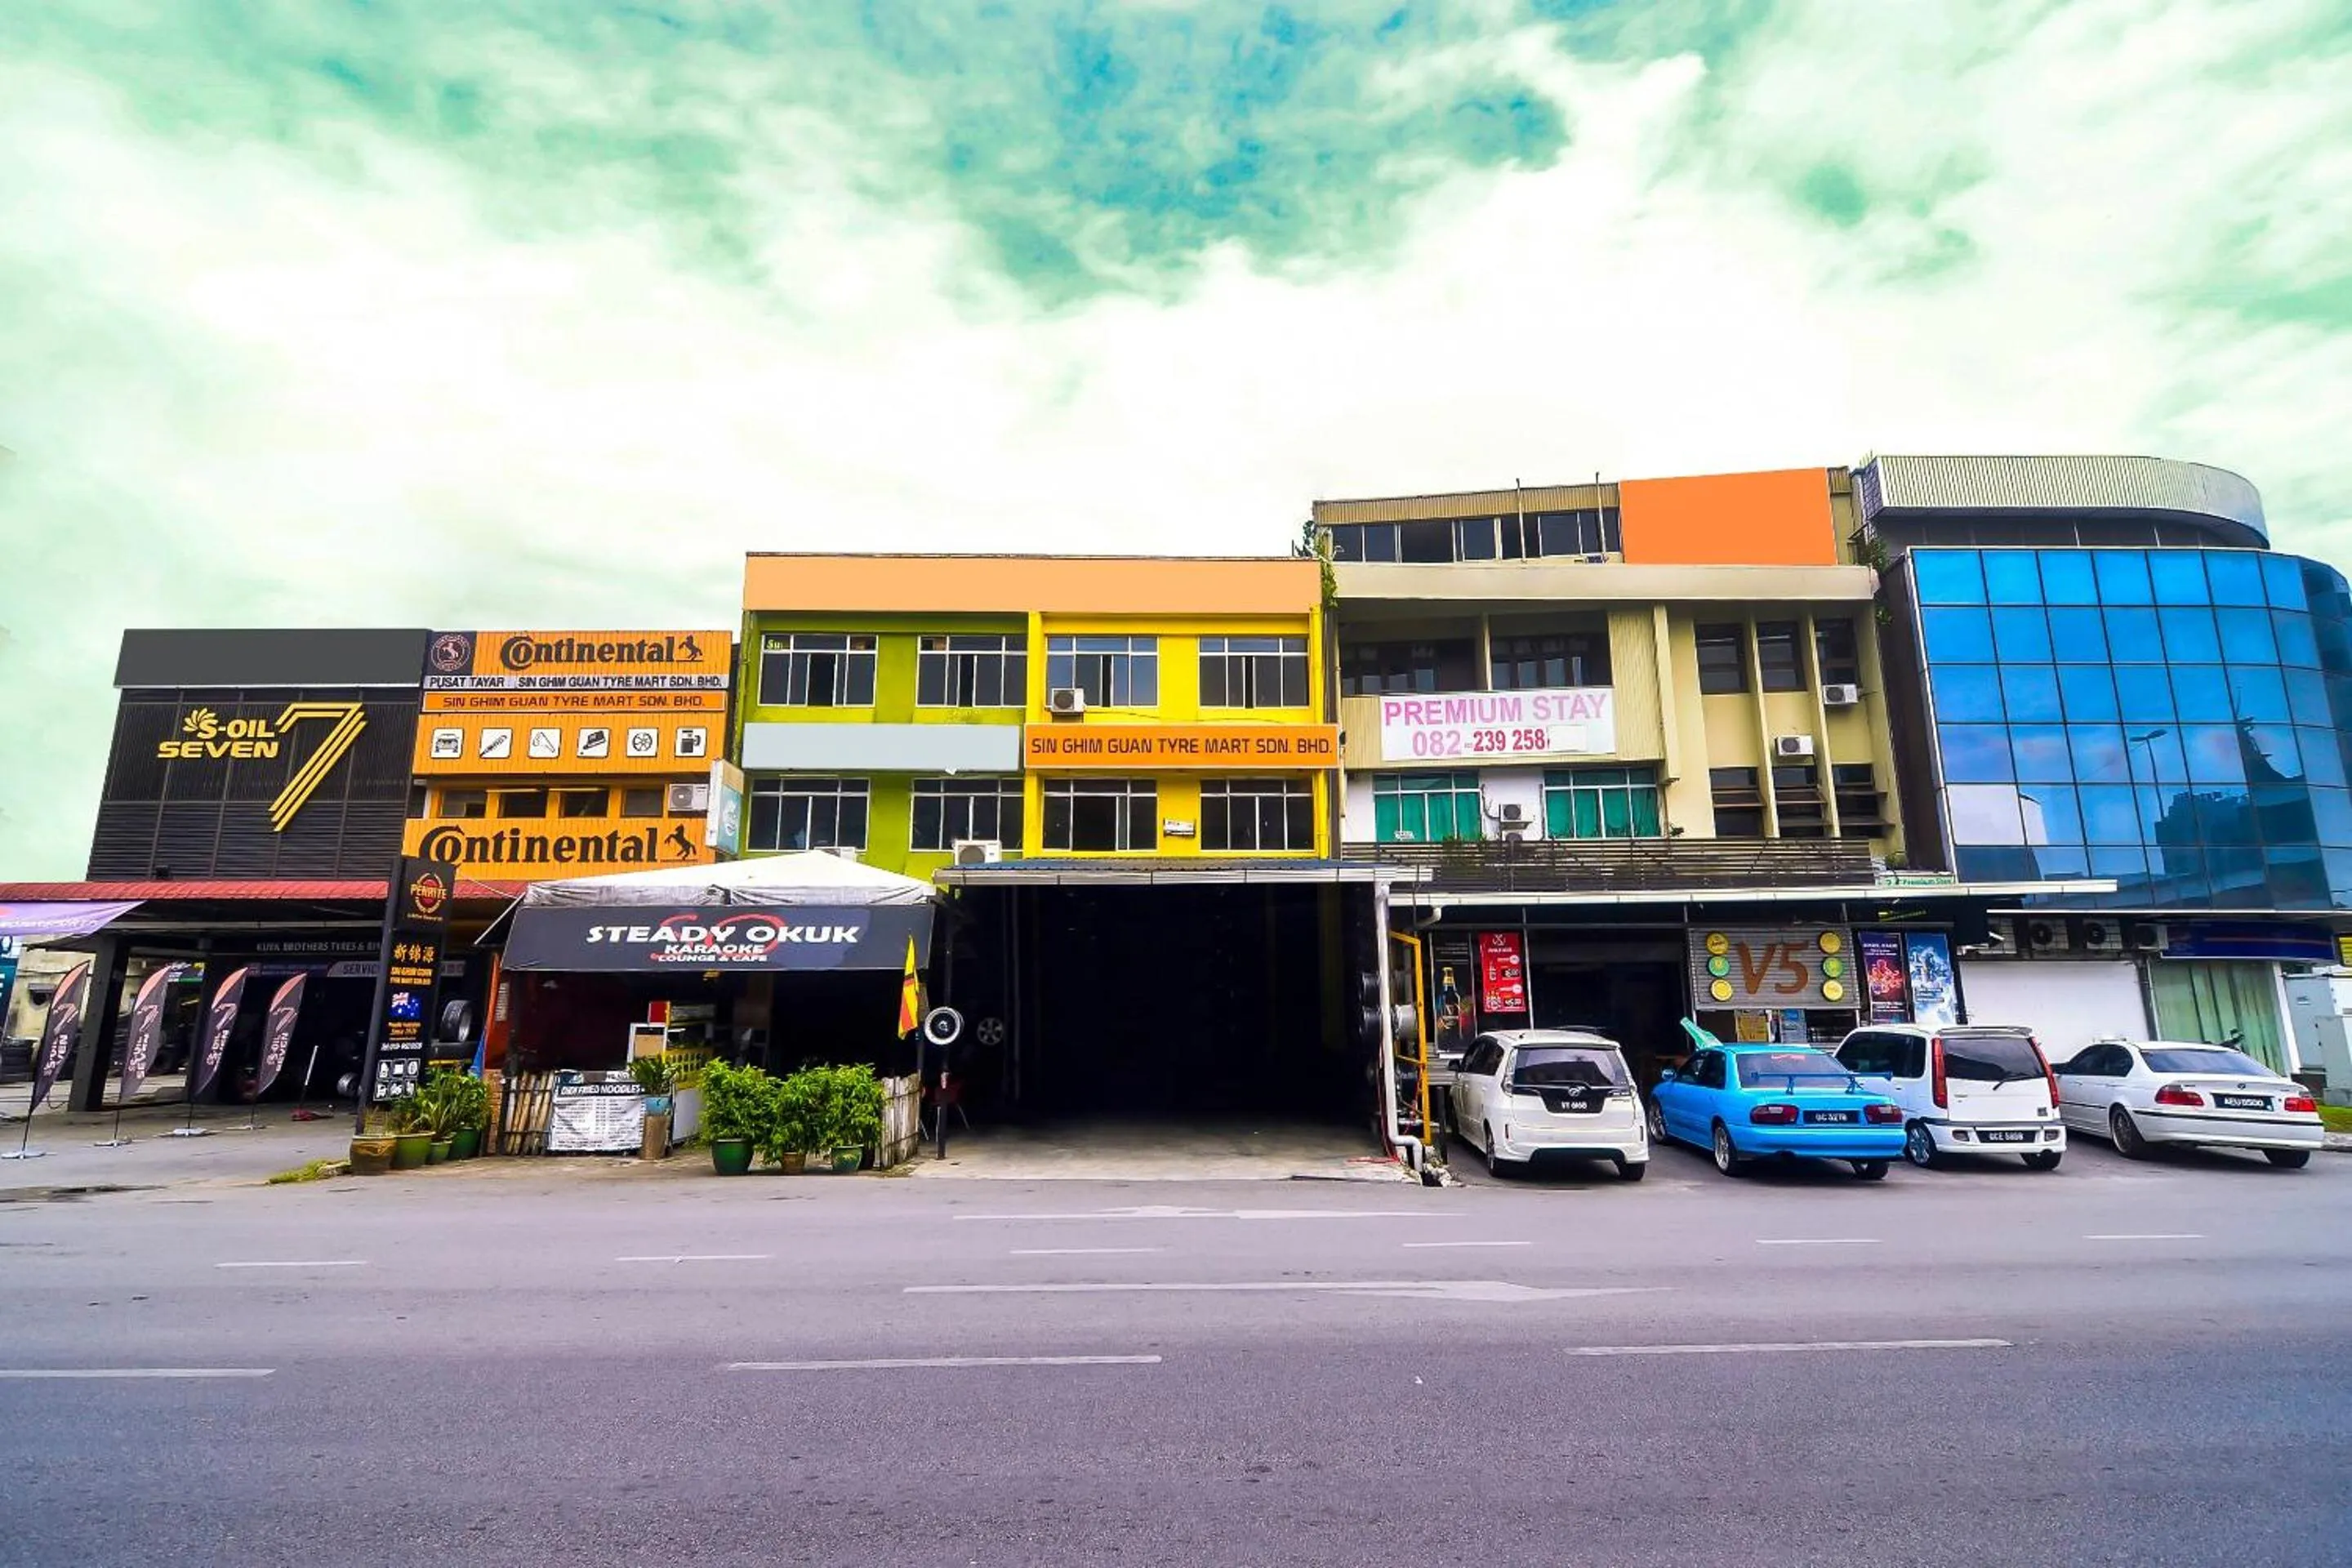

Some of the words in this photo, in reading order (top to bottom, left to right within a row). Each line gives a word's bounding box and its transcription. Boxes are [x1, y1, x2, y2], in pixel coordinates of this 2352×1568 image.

[501, 635, 675, 670] Continental
[430, 677, 466, 688] PUSAT
[470, 677, 505, 688] TAYAR
[518, 677, 537, 688] SIN
[539, 677, 565, 688] GHIM
[568, 677, 600, 688] GUAN
[603, 677, 633, 687] TYRE
[635, 677, 666, 687] MART
[697, 677, 722, 688] BHD.
[443, 697, 465, 708] SIN
[470, 697, 506, 707] GHIM
[509, 697, 548, 706] GUAN
[553, 697, 588, 706] TYRE
[594, 696, 633, 706] MART
[674, 696, 705, 706] BHD.
[1385, 697, 1522, 726] PREMIUM
[1532, 693, 1606, 721] STAY
[196, 718, 275, 739] S-OIL
[158, 742, 279, 759] SEVEN
[1031, 738, 1057, 754] SIN
[1062, 738, 1103, 754] GHIM
[1107, 738, 1152, 754] GUAN
[1157, 738, 1199, 754] TYRE
[1205, 738, 1250, 754] MART
[1255, 738, 1291, 754] SDN.
[1297, 738, 1332, 754] BHD.
[419, 825, 657, 863] Continental
[411, 884, 448, 900] PENRITE
[586, 926, 736, 943] STEADY
[746, 925, 860, 943] OKUK
[283, 942, 328, 951] BROTHERS
[330, 942, 357, 951] TYRES
[665, 944, 766, 955] KARAOKE
[658, 955, 715, 963] LOUNGE
[732, 954, 768, 962] CAFE
[1738, 941, 1811, 995] V5
